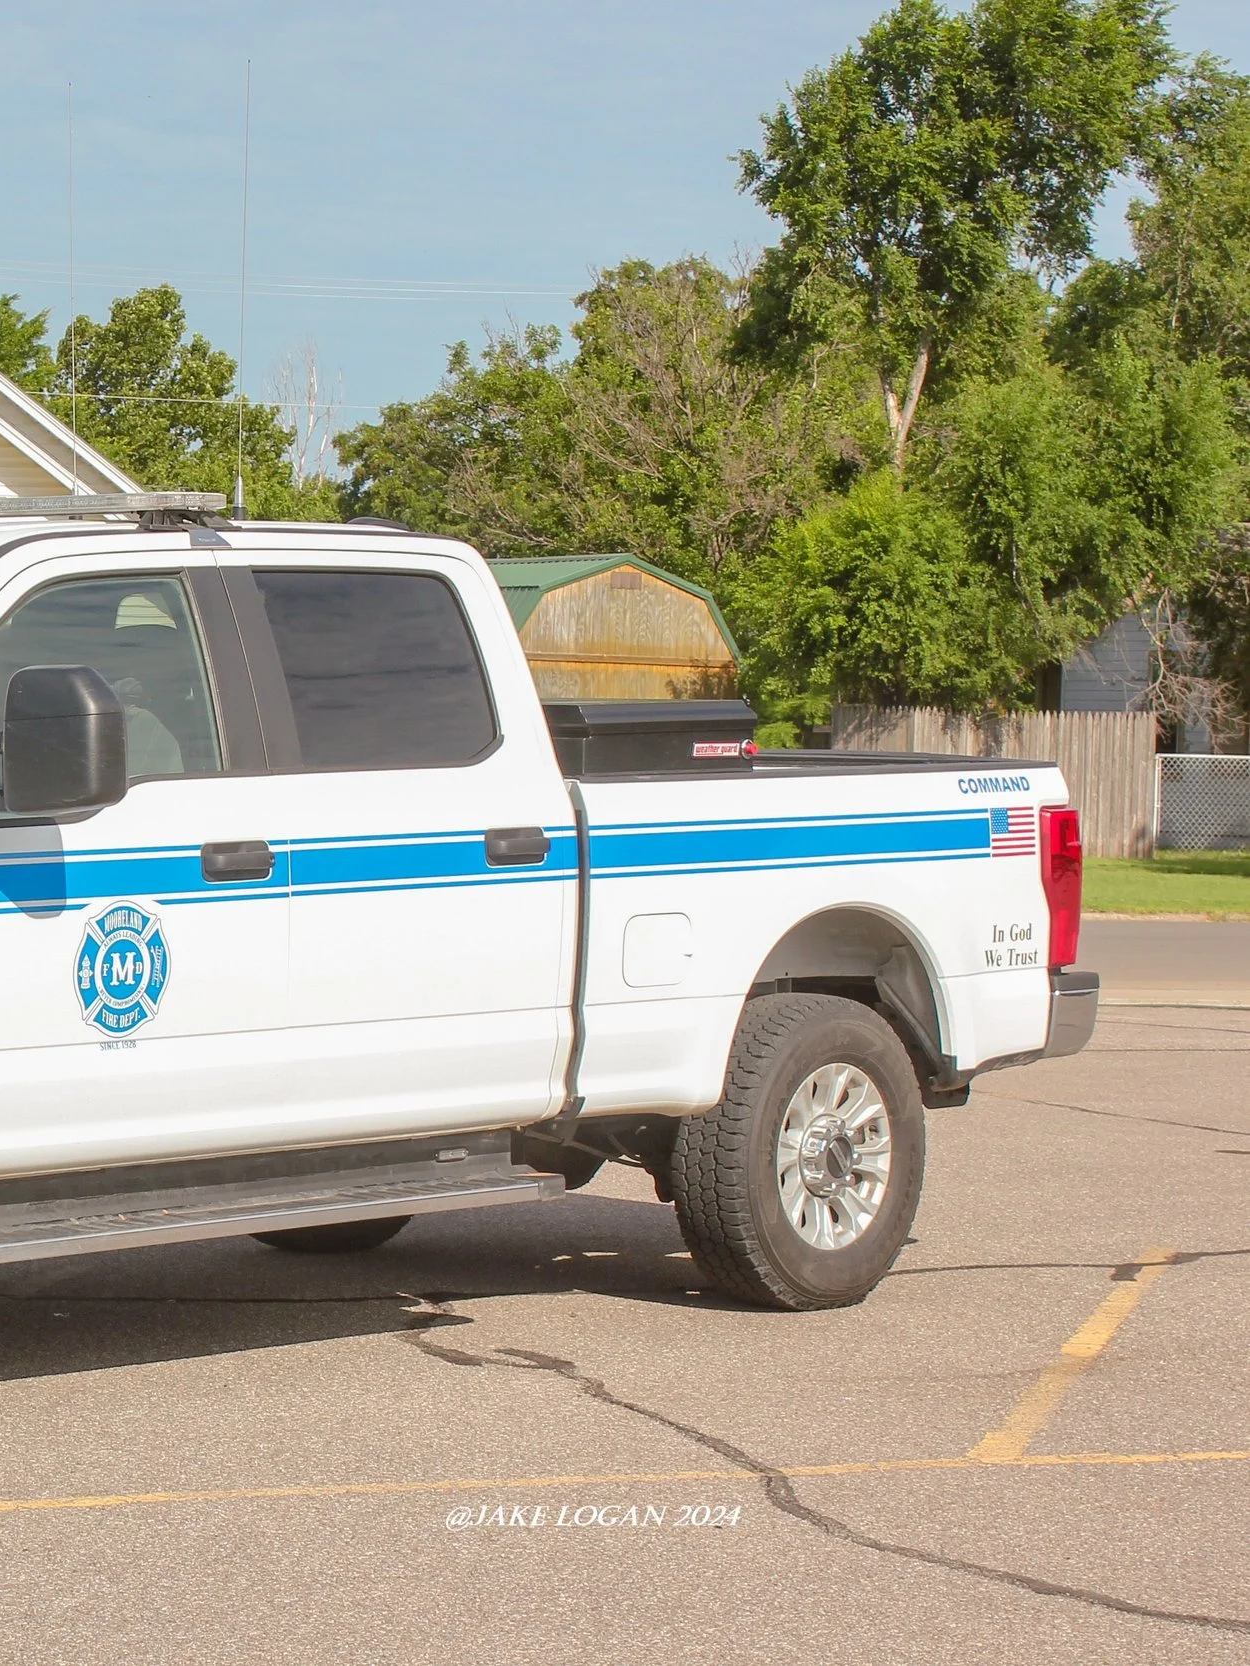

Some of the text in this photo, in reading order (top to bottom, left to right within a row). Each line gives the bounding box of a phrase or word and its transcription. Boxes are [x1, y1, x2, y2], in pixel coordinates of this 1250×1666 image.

[958, 776, 1031, 794] COMMAND
[104, 910, 142, 934] MOORELAND
[103, 931, 121, 949] ALWAYS
[992, 923, 1032, 943] In God
[984, 948, 1038, 967] We Trust
[102, 1007, 141, 1028] FIRE DEPT.
[100, 1041, 120, 1050] SINCE
